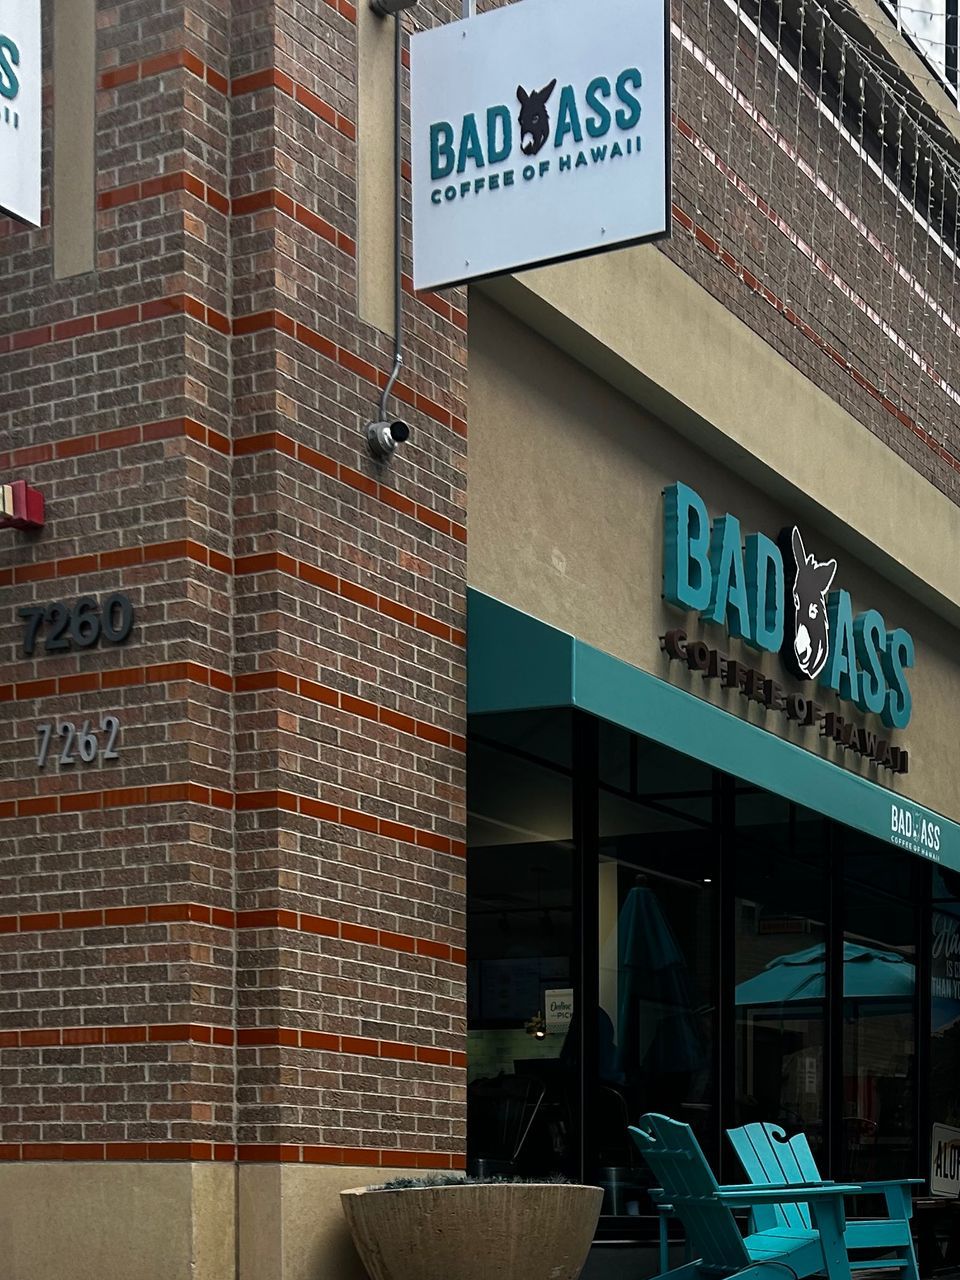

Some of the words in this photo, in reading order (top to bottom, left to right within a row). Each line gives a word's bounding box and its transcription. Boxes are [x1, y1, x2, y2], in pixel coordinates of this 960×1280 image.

[430, 104, 513, 181] BAD
[554, 67, 642, 148] ASS
[430, 170, 515, 204] COFFEE
[522, 160, 551, 181] OF
[559, 136, 642, 172] HAWAII
[18, 593, 134, 654] 7260
[663, 480, 786, 654] BAD
[823, 588, 915, 730] ASS
[663, 629, 784, 711] COFFEE
[785, 692, 825, 725] OF
[823, 712, 909, 774] HAWAII
[37, 716, 119, 767] 7262
[890, 835, 912, 850] COFFEE
[891, 804, 912, 838] BAD
[920, 818, 941, 851] ASS
[931, 976, 952, 998] THAN
[946, 960, 953, 977] IS
